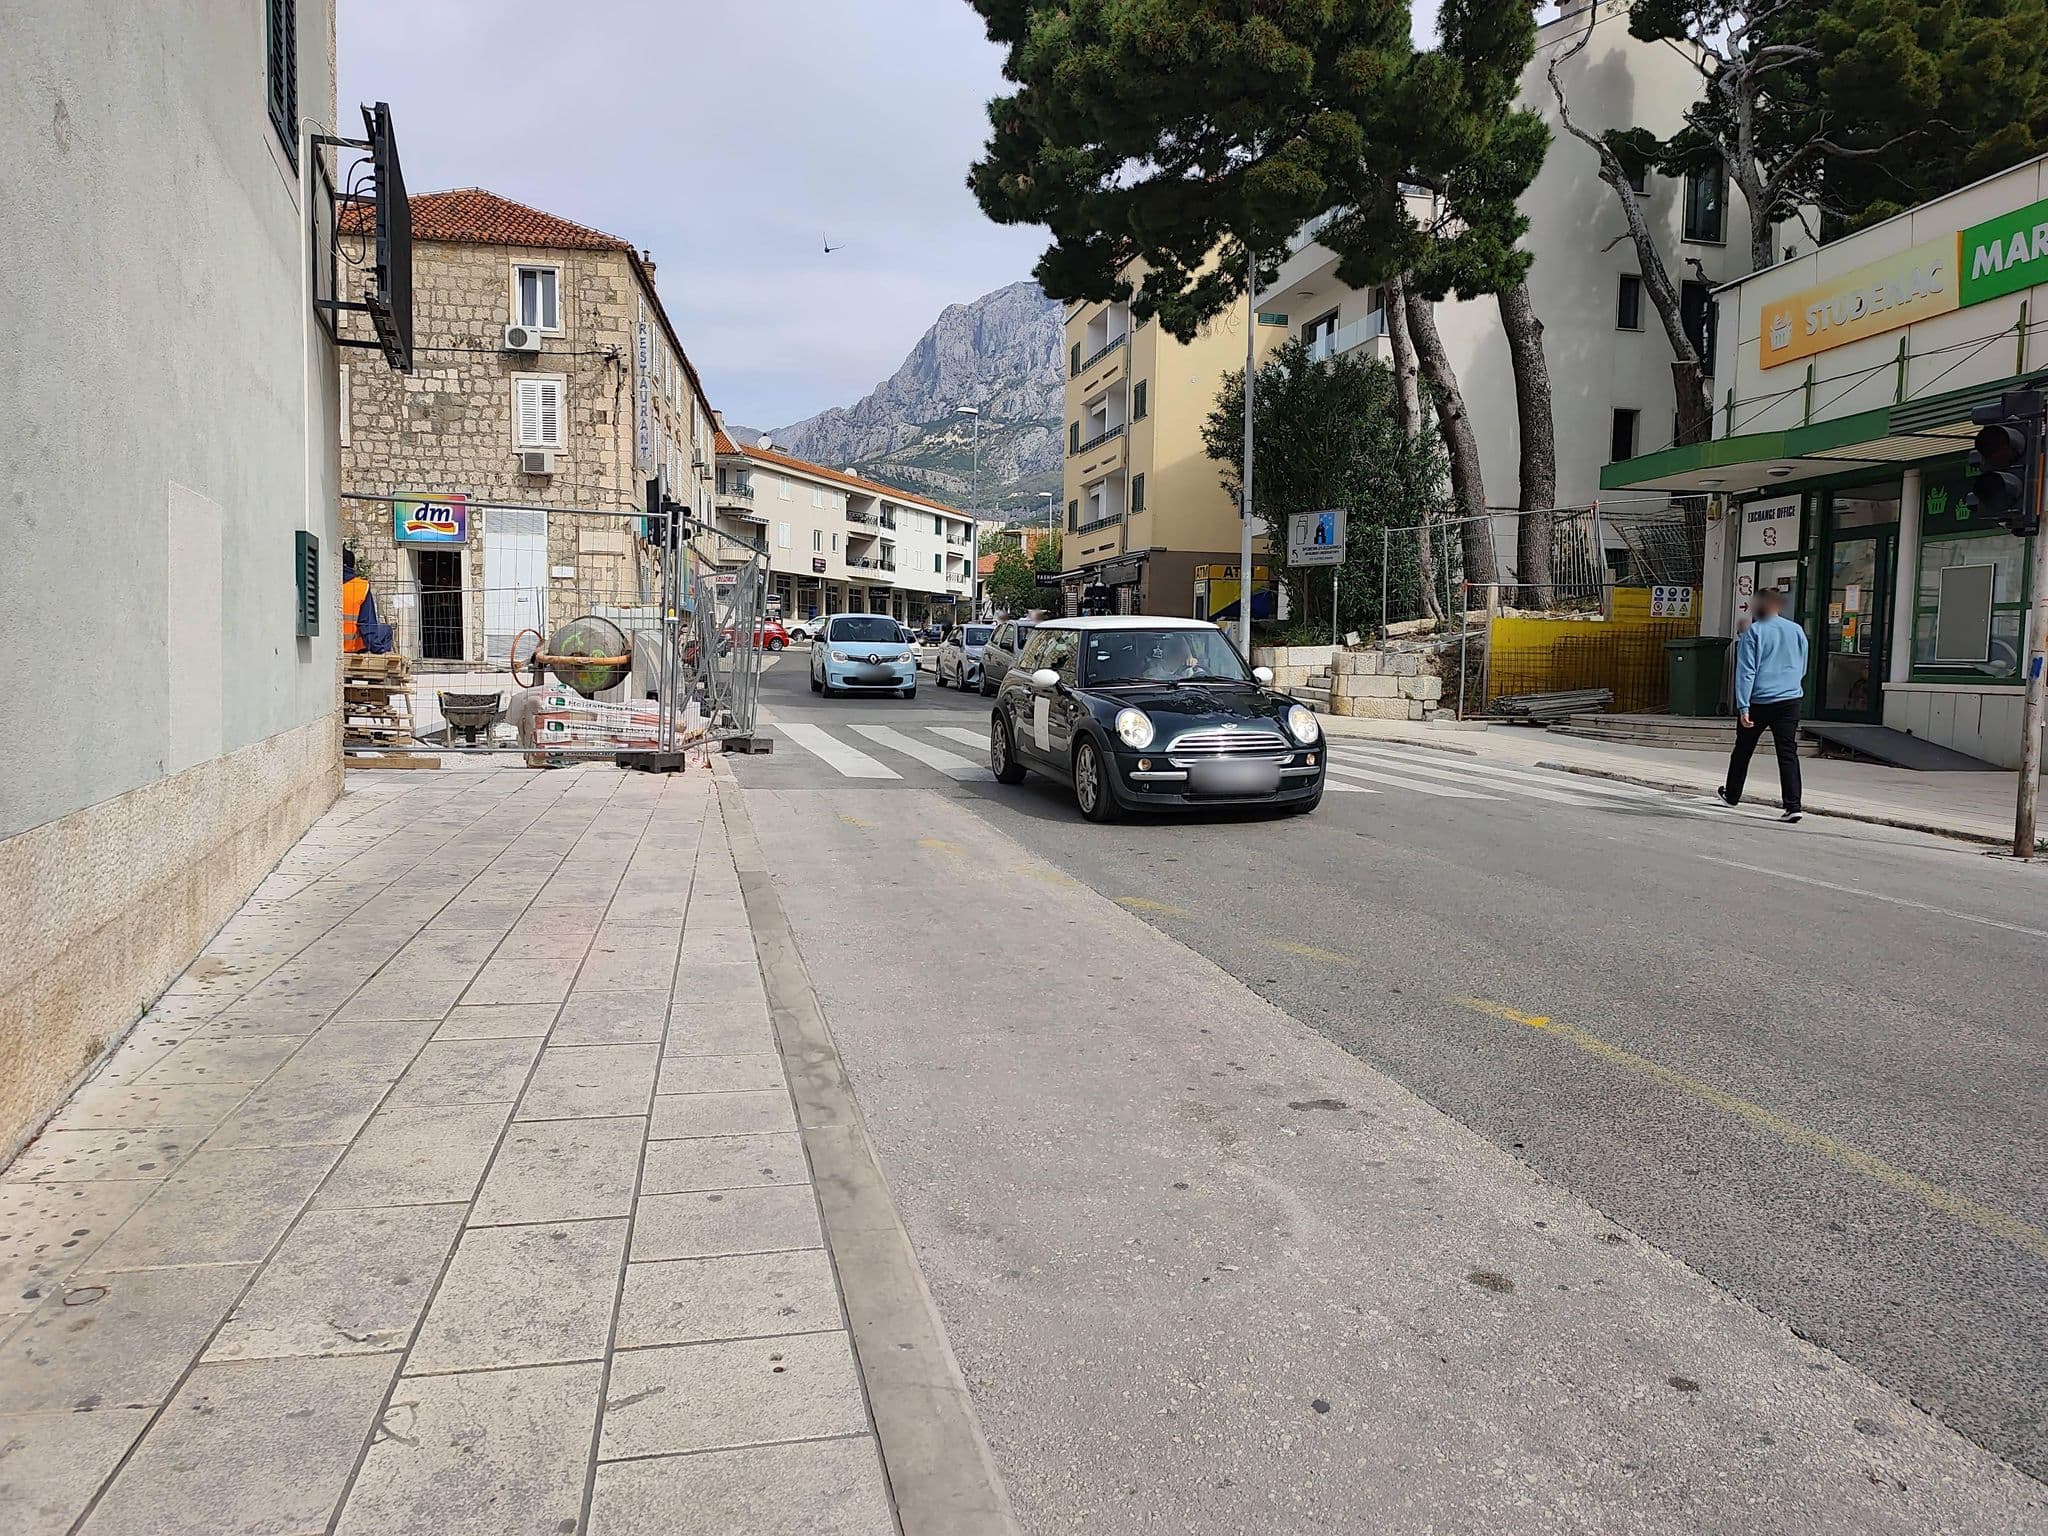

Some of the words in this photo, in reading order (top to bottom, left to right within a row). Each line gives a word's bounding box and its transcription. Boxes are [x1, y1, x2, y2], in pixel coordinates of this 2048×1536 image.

[1805, 259, 1944, 336] STUDENAC
[639, 323, 649, 459] RESTAURANT
[414, 500, 451, 522] dm
[1747, 508, 1776, 523] EXCHANGE
[1777, 505, 1796, 519] OFFICE
[1223, 566, 1255, 578] AT
